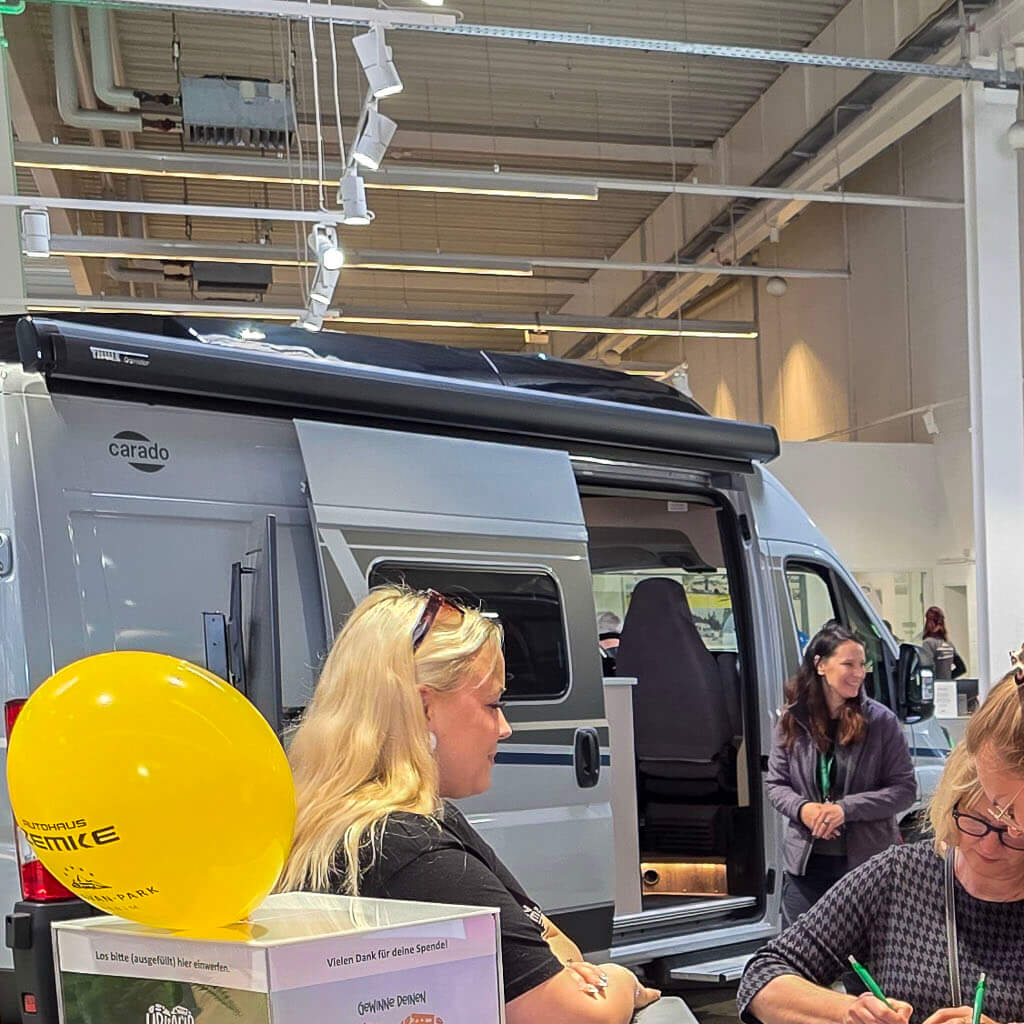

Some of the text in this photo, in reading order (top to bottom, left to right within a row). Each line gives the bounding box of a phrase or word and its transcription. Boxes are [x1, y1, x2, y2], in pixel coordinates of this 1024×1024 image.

[109, 442, 169, 460] carado
[95, 951, 109, 961] Los
[110, 952, 129, 963] bitte
[131, 953, 176, 969] (ausgefüllt)
[177, 957, 192, 969] hier
[327, 939, 449, 968] Vielen Dank für deine Spende!
